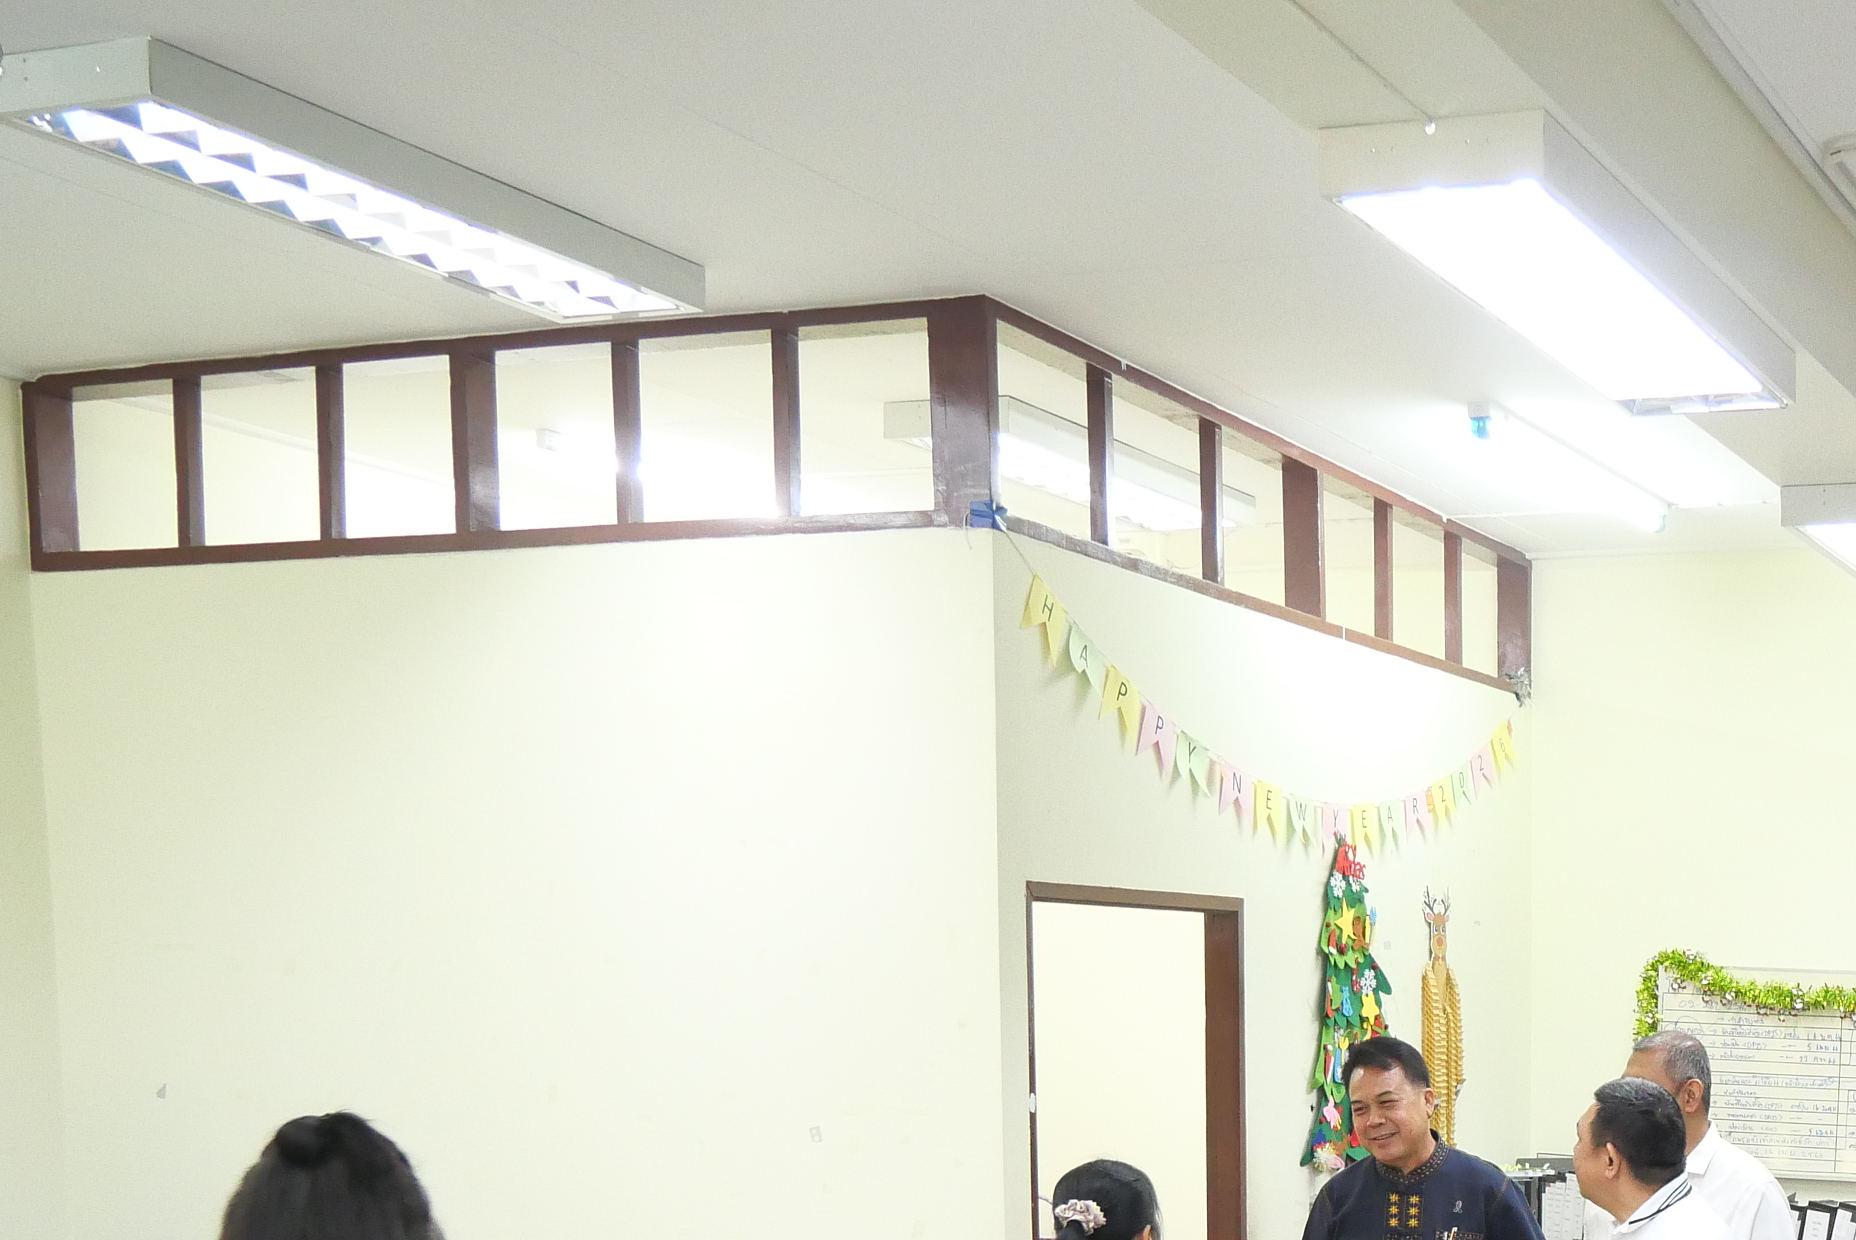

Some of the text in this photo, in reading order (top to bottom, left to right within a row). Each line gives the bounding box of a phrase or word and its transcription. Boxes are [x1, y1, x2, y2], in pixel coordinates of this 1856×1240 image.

[1041, 593, 1506, 829] HAPPY NEW YEAR 2026
